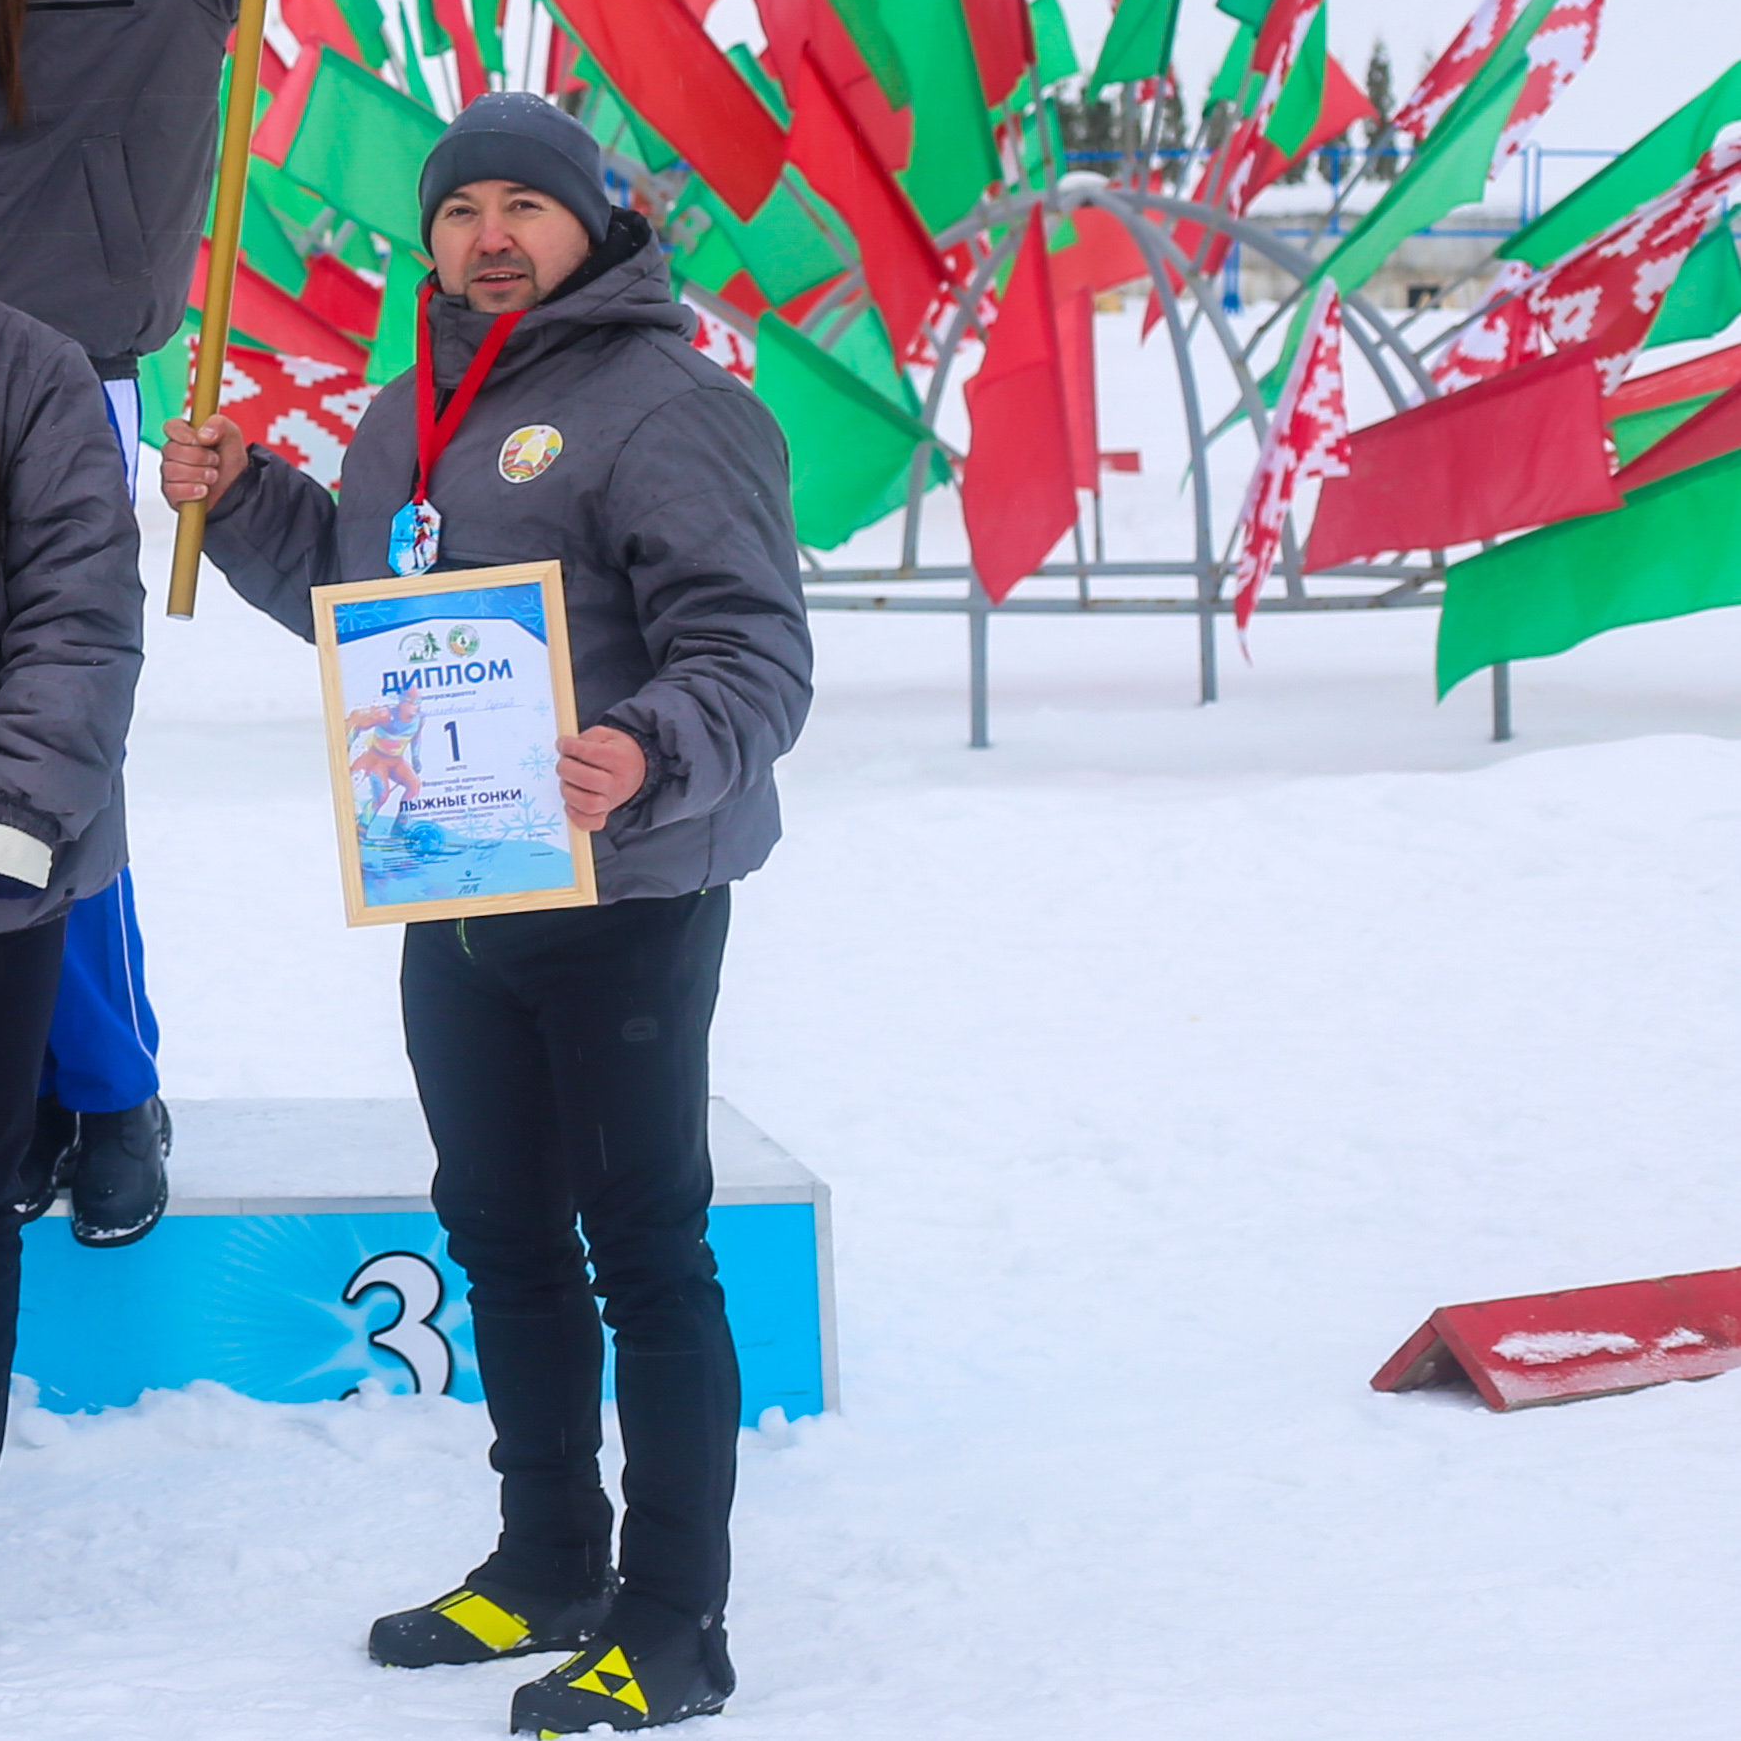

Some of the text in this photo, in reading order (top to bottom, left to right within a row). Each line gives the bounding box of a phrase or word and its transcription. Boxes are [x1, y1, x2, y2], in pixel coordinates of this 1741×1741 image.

[380, 658, 514, 696] ДИПЛОМ
[444, 721, 460, 762] 1
[399, 789, 522, 813] ЛЫЖНЫЕ ГОНКИ
[340, 1250, 454, 1398] 3
